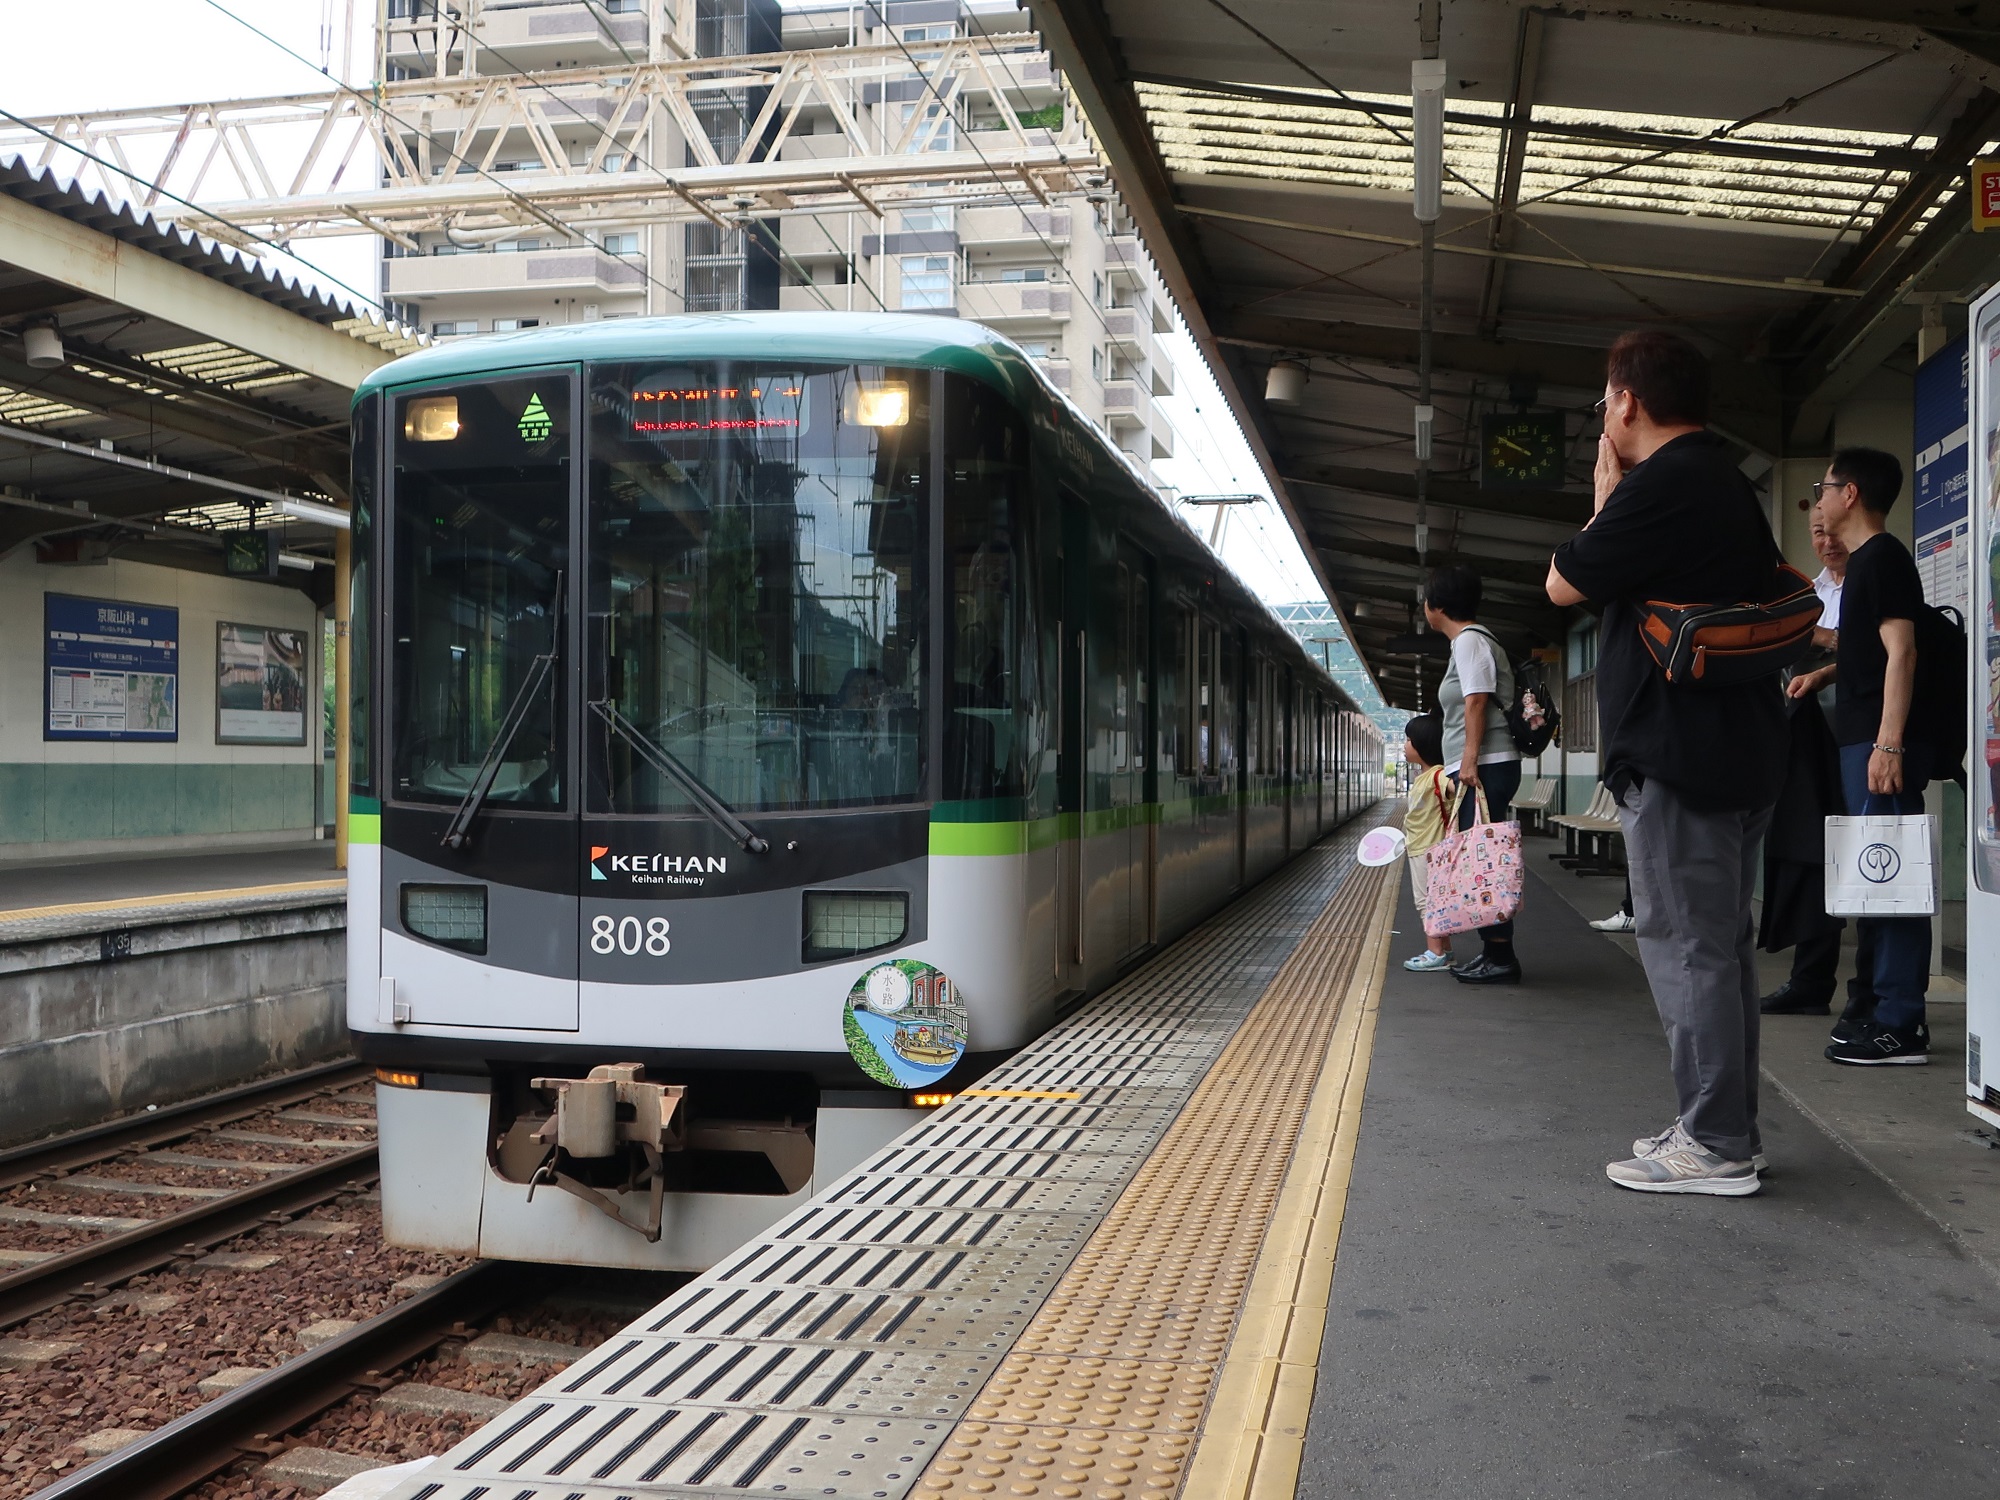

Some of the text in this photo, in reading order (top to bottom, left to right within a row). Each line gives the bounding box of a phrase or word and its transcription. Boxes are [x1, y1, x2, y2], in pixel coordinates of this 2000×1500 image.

[97, 608, 135, 626] 京阪山科
[611, 853, 727, 874] KEIHAN
[631, 874, 705, 886] Keihan Railway
[590, 915, 671, 957] 808
